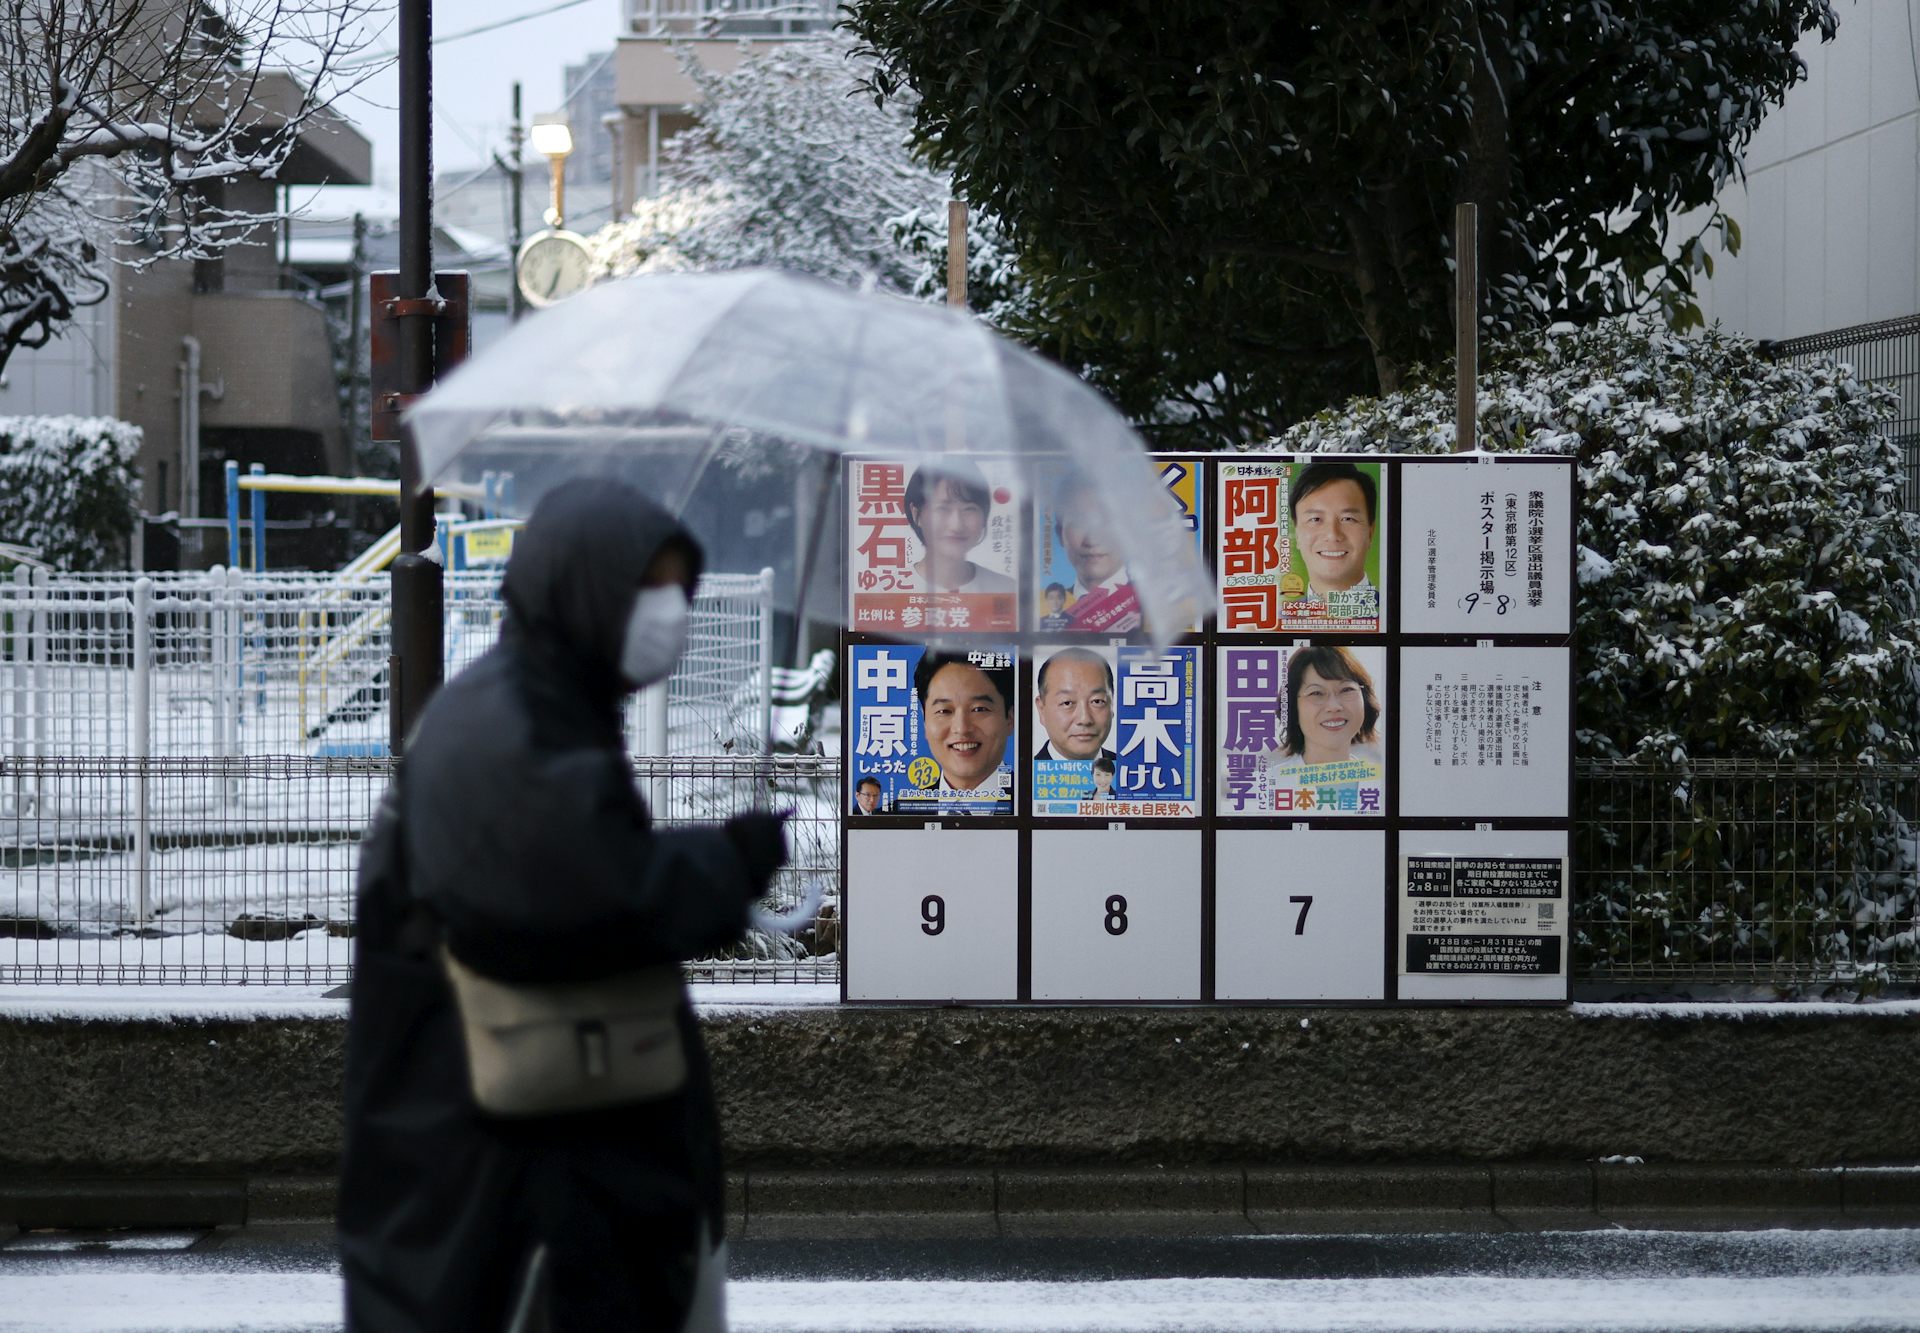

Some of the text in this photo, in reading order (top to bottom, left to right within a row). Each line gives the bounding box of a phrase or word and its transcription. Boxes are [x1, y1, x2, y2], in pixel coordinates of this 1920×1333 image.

[857, 464, 911, 568] 黒石
[1480, 491, 1495, 595] ポスター掲示場
[1504, 492, 1518, 577] （東京都第12区）
[1222, 478, 1280, 630] 阿部司
[1281, 538, 1290, 573] 3児の父
[1528, 490, 1544, 608] 衆議院小選挙区選出議員選挙
[858, 570, 914, 591] ゆうこ
[1226, 575, 1275, 585] あべ つかさ
[858, 608, 896, 622] 比例は
[901, 606, 970, 628] 参政党
[968, 650, 996, 668] 中道
[856, 650, 908, 758] 中原
[1120, 654, 1182, 764] 高木
[1532, 681, 1542, 716] 注意
[1224, 650, 1278, 810] 田原聖子
[859, 760, 906, 774] しょうた
[914, 758, 928, 768] 新人
[1119, 764, 1182, 791] けい
[1258, 755, 1268, 810] たはらせいこ
[1300, 768, 1376, 784] 給料あげる政治に
[1078, 802, 1193, 816] 比例代表も自民党へ
[1274, 788, 1380, 810] 日本共産党
[930, 823, 936, 831] 9
[1456, 880, 1559, 888] 各ご家庭へ届かない見込みです
[1467, 870, 1548, 878] 期日前投票開始日までに
[920, 894, 946, 936] 9
[1104, 894, 1129, 936] 8
[1289, 895, 1314, 936] 7
[1430, 954, 1538, 962] 衆議院議員選挙と国民審査の両方が
[1440, 946, 1527, 954] 国民審査の投票はできません
